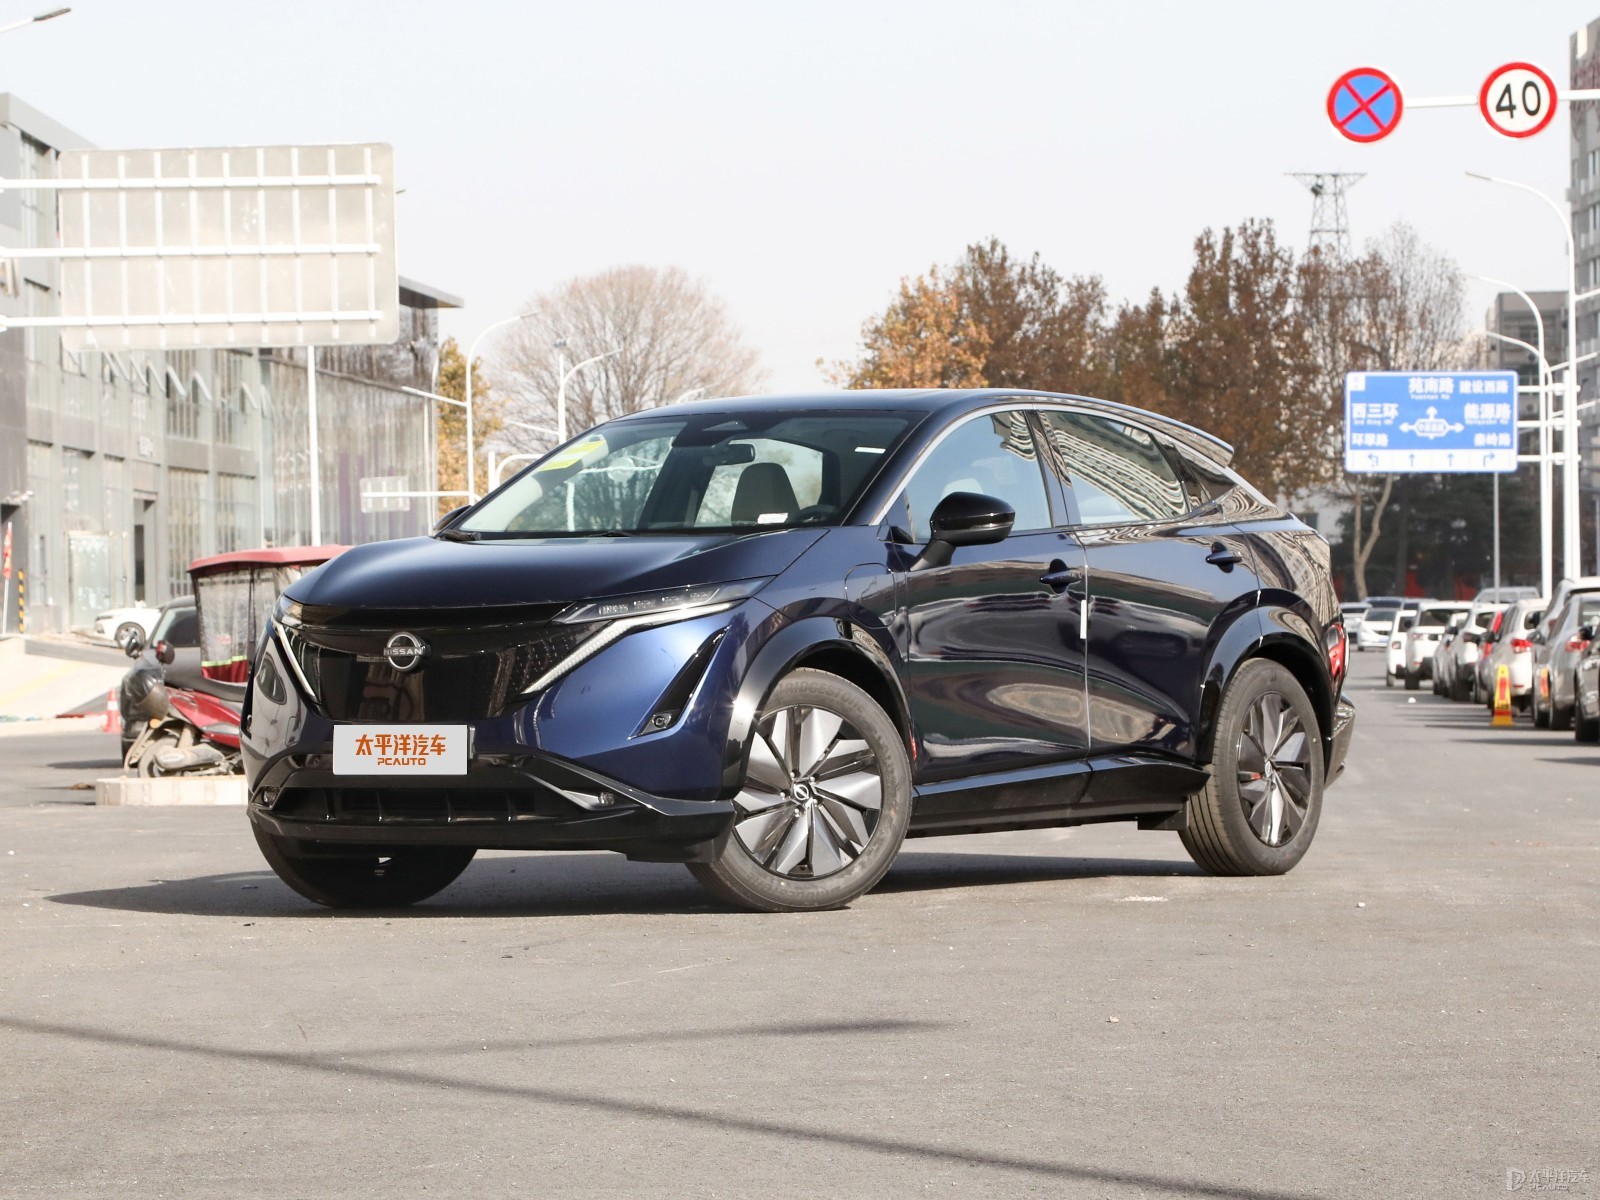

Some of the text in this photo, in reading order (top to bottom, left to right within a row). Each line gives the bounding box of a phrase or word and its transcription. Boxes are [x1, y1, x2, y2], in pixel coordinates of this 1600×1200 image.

[1495, 80, 1541, 119] 40
[1352, 403, 1399, 419] 西三环
[383, 648, 422, 656] NISSAN
[355, 734, 446, 755] 太平洋汽车
[377, 757, 426, 766] PCAUTO
